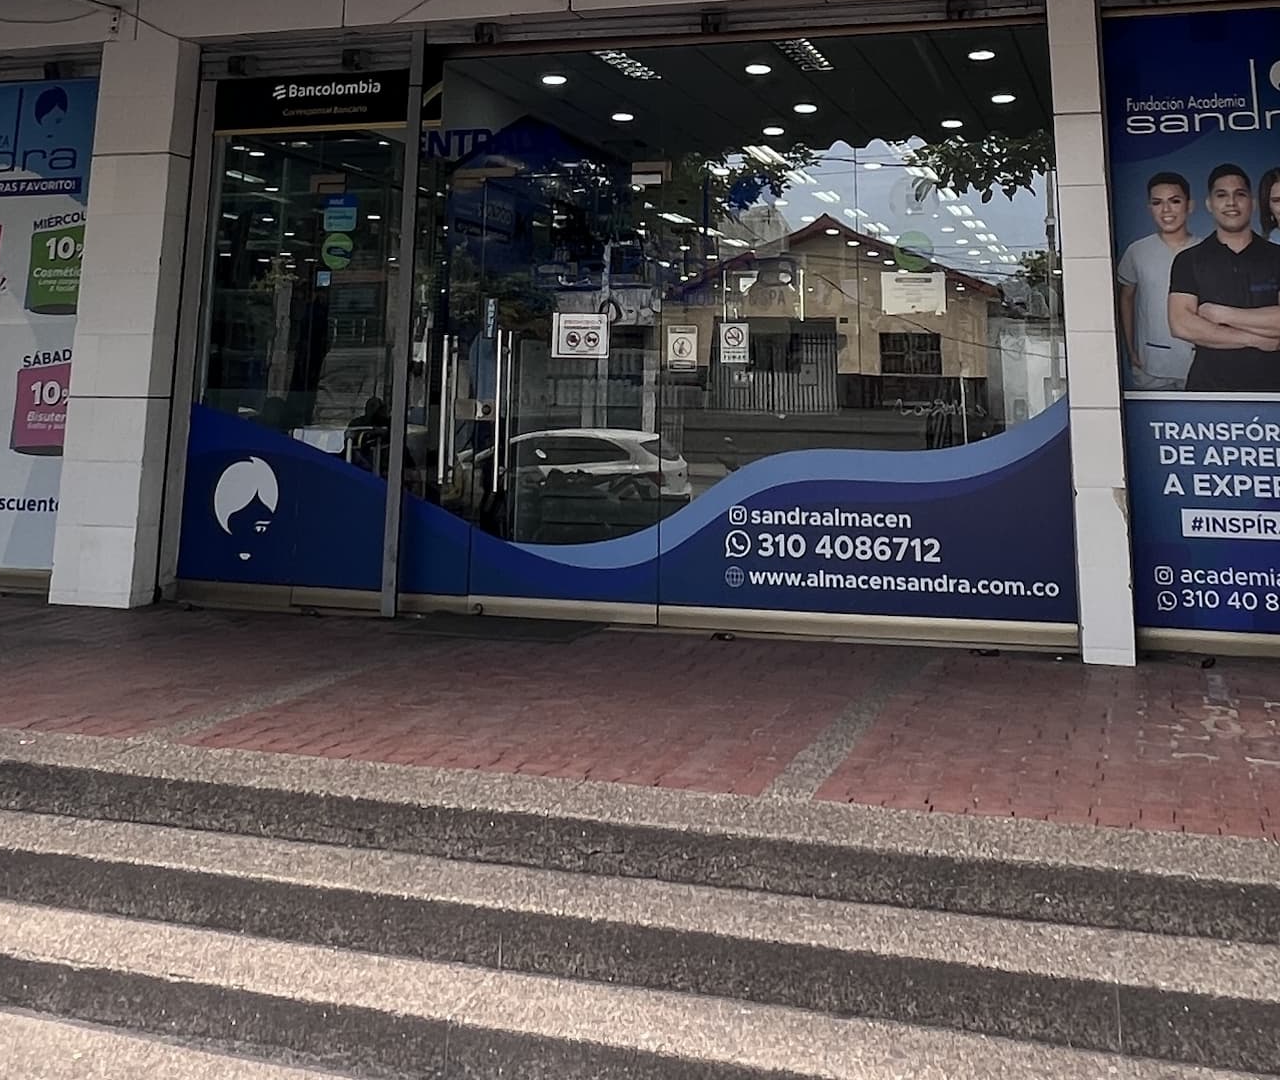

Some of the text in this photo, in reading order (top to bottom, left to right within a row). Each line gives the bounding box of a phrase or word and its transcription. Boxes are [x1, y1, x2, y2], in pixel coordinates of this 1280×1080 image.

[288, 78, 381, 98] Bancolombia
[1126, 92, 1246, 112] Fundación Academia
[19, 178, 76, 192] FAVORITO!
[1159, 445, 1196, 465] DE
[1162, 472, 1186, 496] A
[750, 507, 912, 529] sandraalmacen
[757, 533, 942, 563] 310 4086712
[748, 569, 1061, 599] www.almacensandra.com.co
[1181, 588, 1221, 609] 310
[1227, 591, 1259, 611] 40
